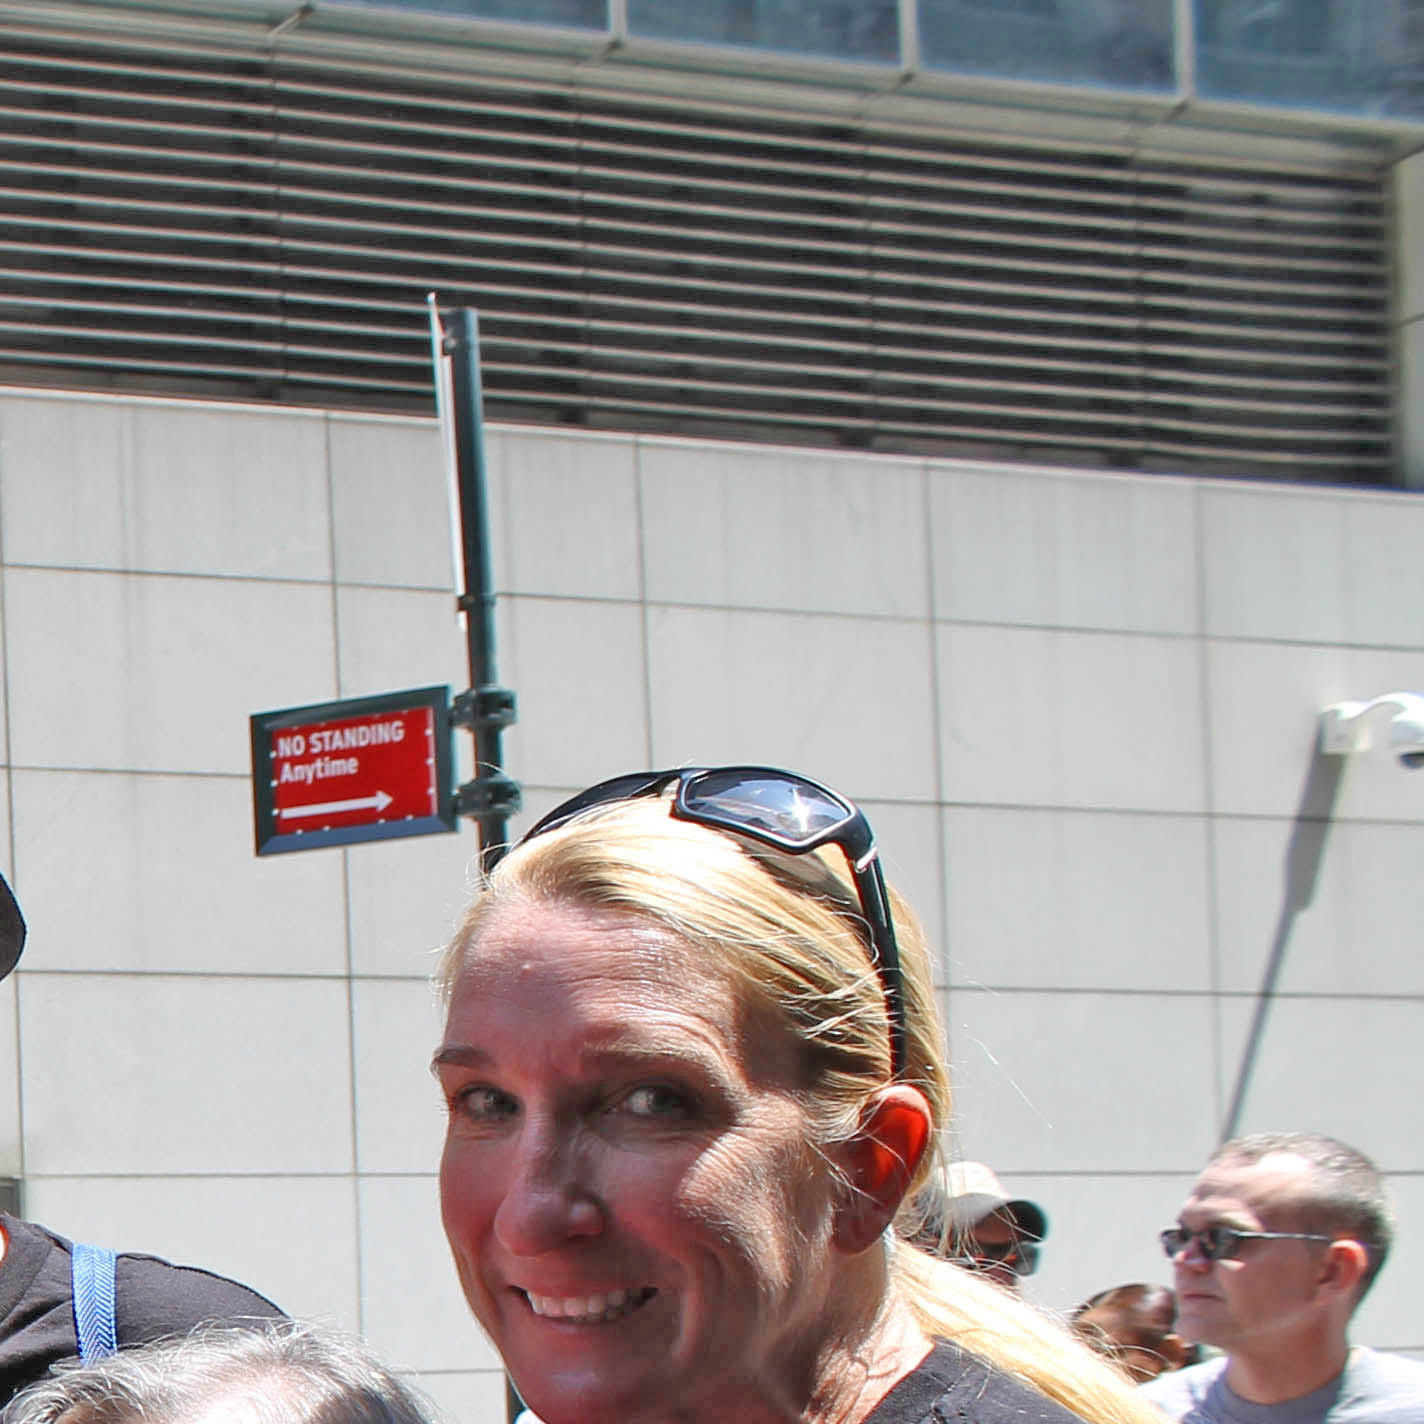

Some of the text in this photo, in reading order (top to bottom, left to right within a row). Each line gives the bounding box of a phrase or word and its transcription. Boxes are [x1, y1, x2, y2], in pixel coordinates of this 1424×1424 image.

[277, 720, 405, 758] NO STANDING
[280, 757, 359, 784] Anytime
